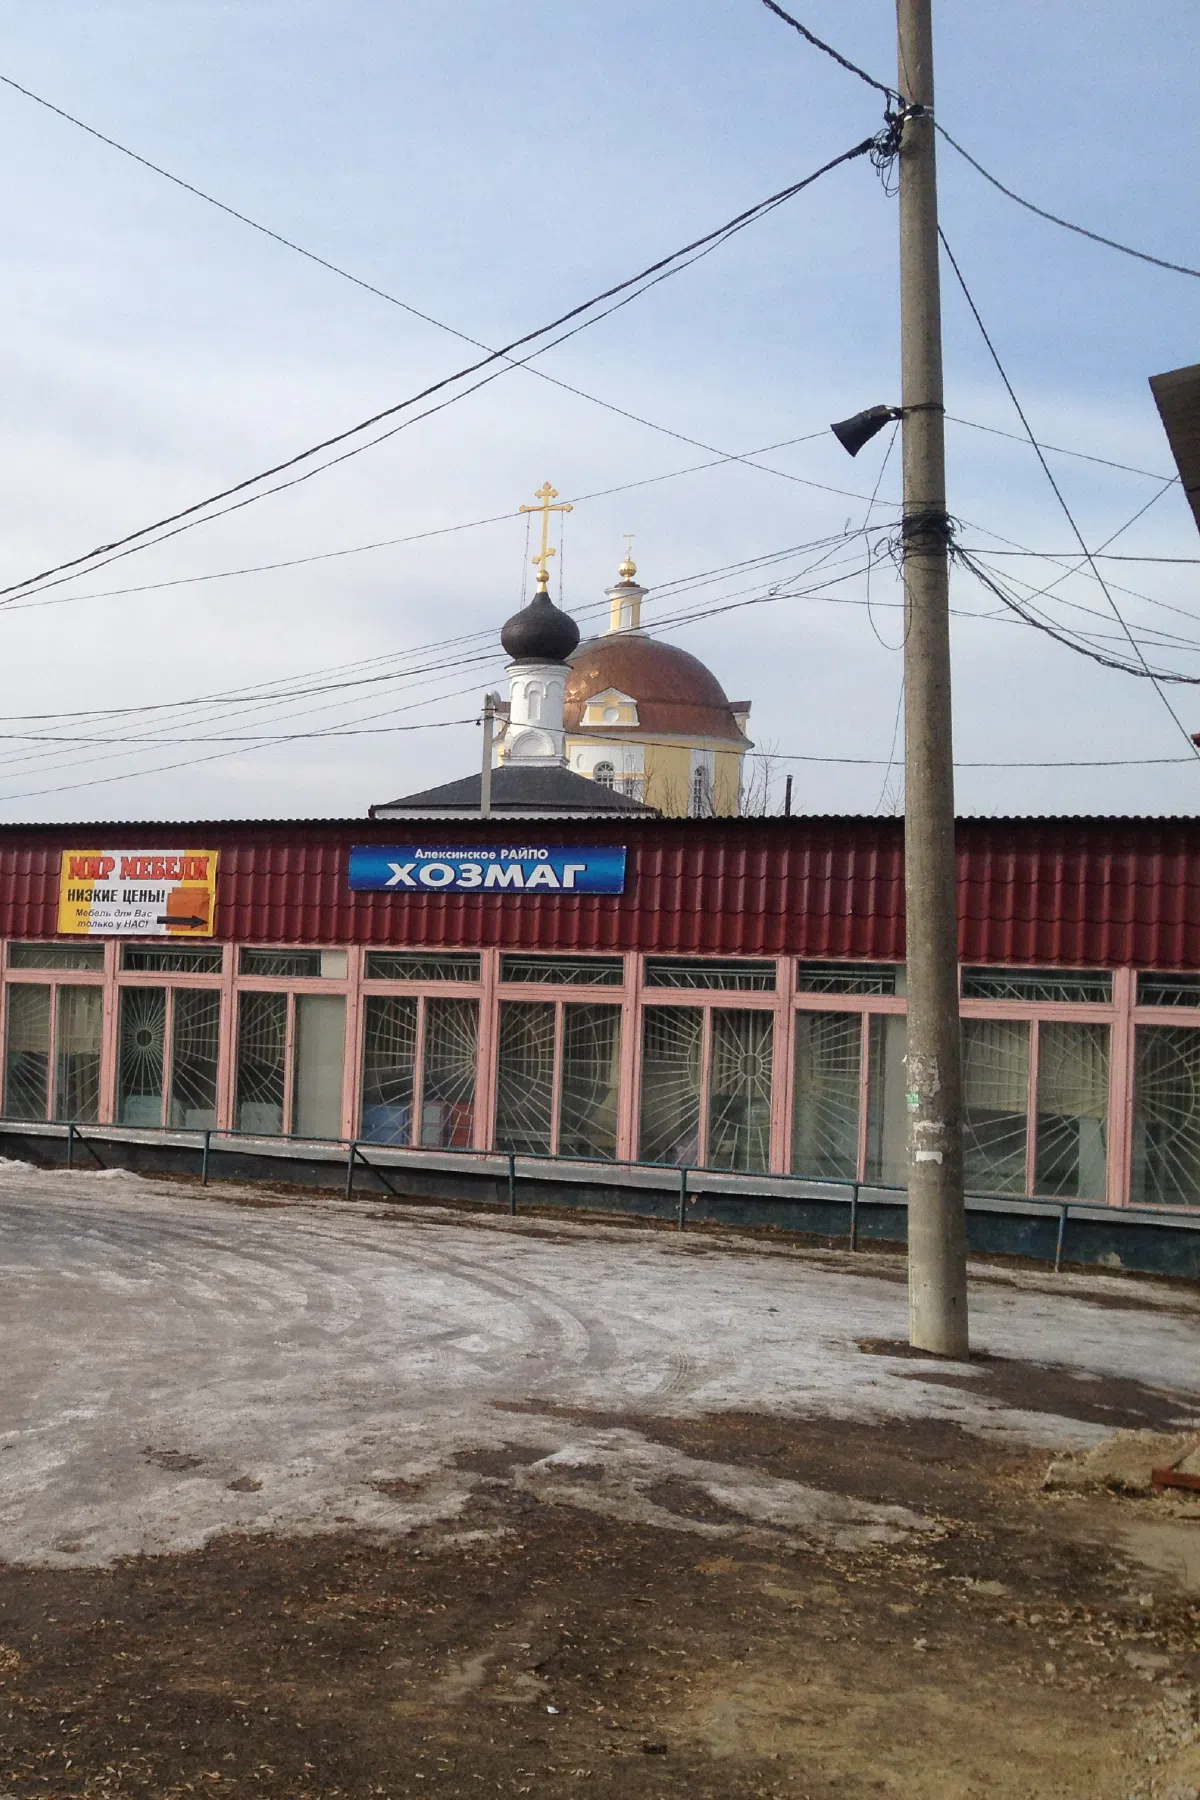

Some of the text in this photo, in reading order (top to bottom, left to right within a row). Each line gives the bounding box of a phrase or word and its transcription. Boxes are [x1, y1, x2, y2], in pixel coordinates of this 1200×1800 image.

[414, 847, 549, 860] Алексинское РАЙПО
[68, 856, 210, 881] МИР МЕБЕЛИ
[384, 863, 586, 888] ХОЗМАГ
[67, 889, 166, 904] НИЗКИЕ ЦЕНЫ!
[75, 909, 153, 918] Мебель для Вас
[116, 921, 123, 930] у
[124, 920, 149, 928] НАС!
